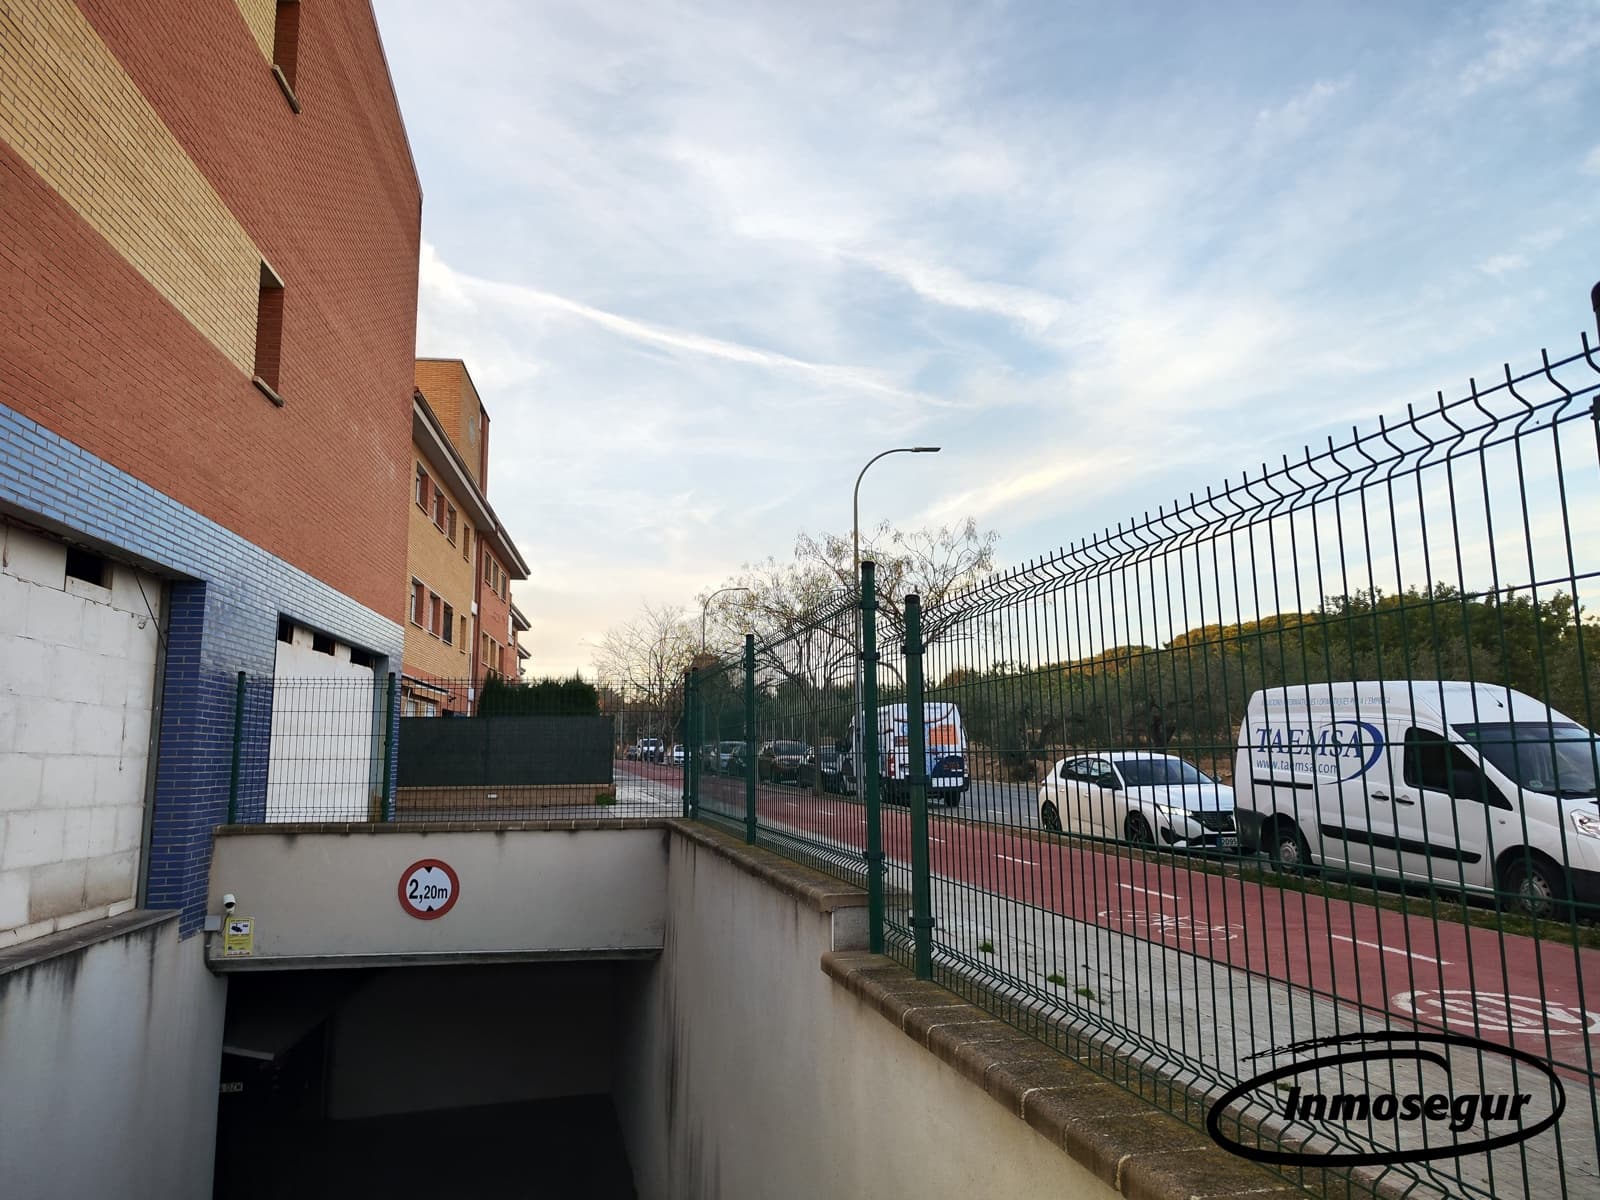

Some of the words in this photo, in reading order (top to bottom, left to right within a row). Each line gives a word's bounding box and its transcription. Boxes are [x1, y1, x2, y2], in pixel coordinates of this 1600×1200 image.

[1256, 728, 1363, 758] TAEMSA
[1256, 759, 1339, 774] www.tamsacom
[409, 878, 448, 904] 2,20m
